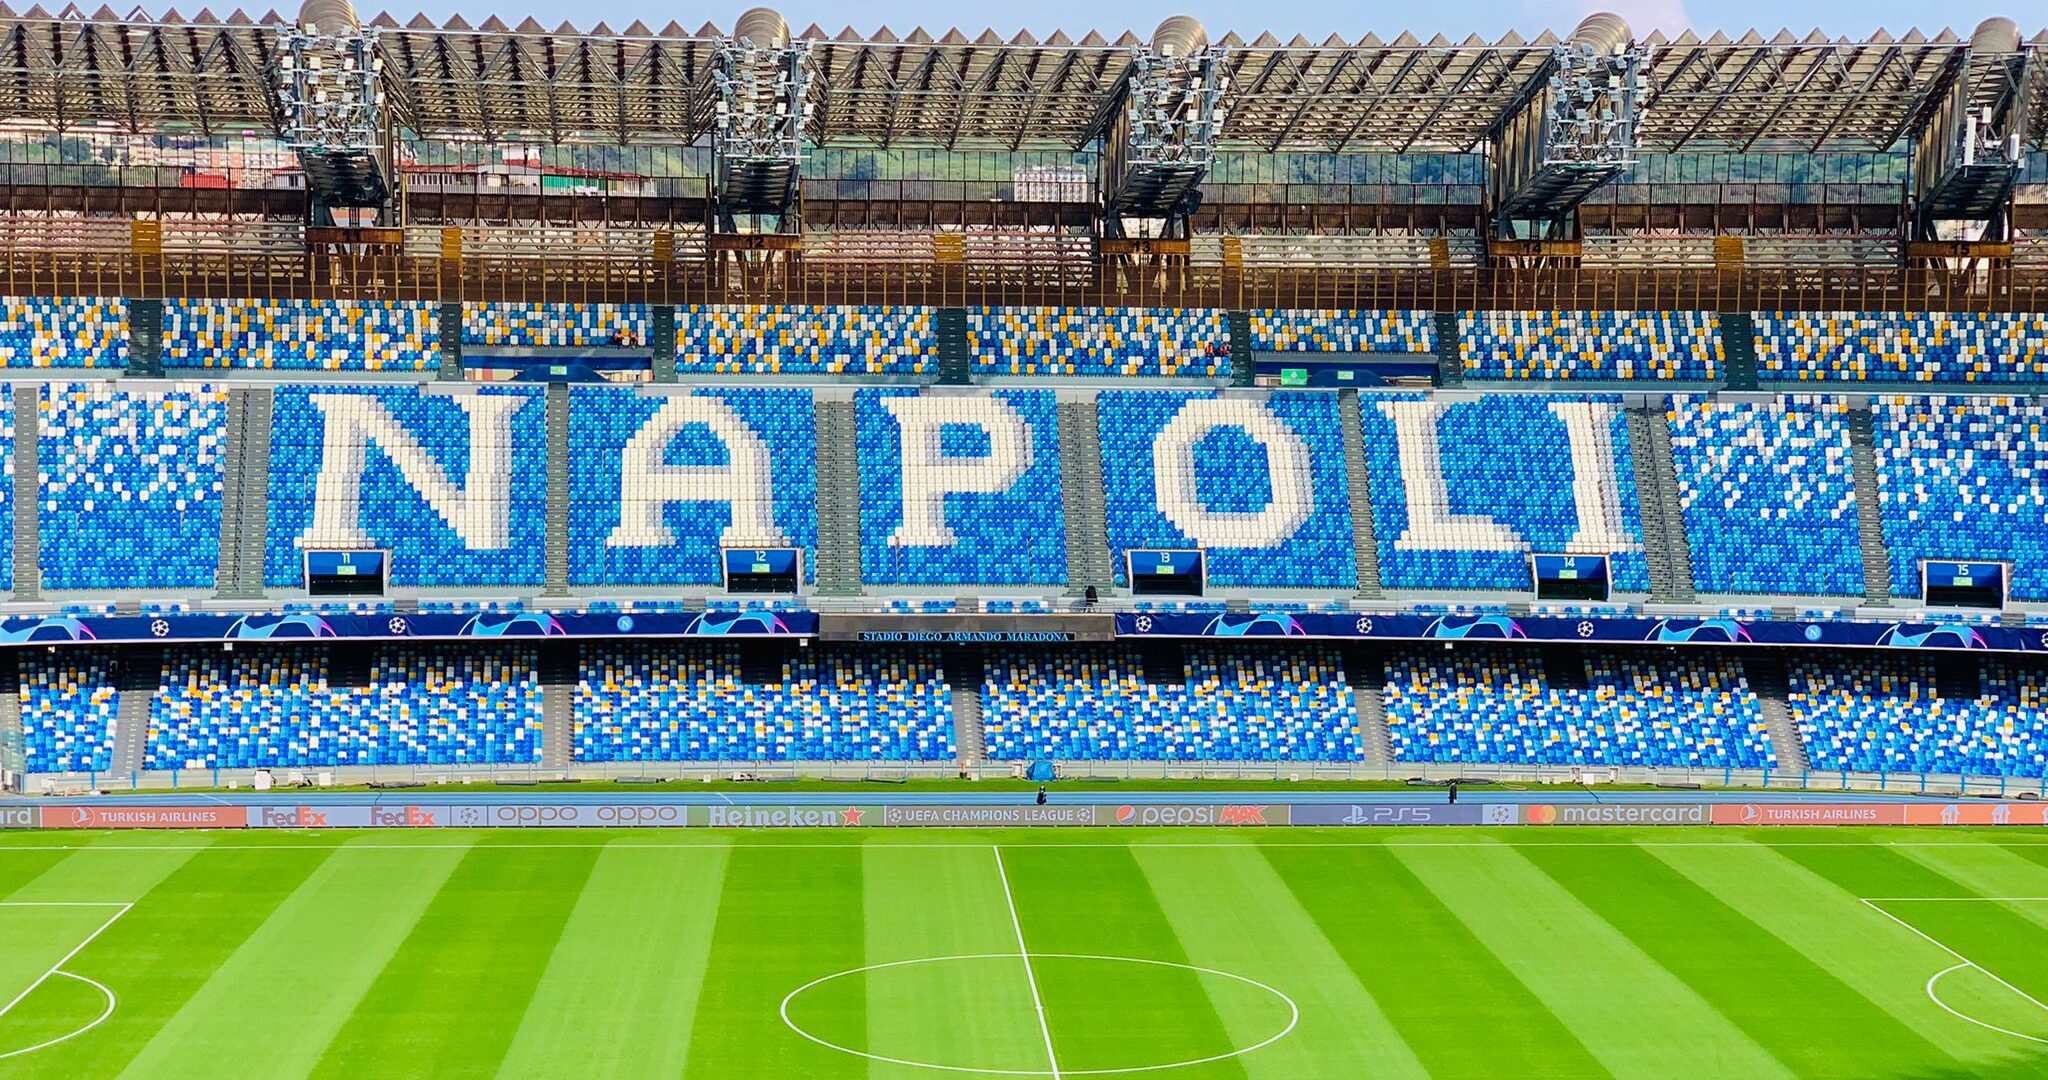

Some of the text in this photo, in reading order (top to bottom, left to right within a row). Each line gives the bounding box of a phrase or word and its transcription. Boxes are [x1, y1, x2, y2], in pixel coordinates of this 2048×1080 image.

[747, 236, 764, 248] 12
[1134, 240, 1151, 252] 13
[1523, 240, 1542, 254] 14
[294, 393, 1646, 554] NAPOLI
[341, 552, 351, 564] 11
[755, 550, 767, 562] 12
[1160, 552, 1171, 563] 13
[1564, 556, 1576, 567] 14
[1957, 564, 1970, 576] 15
[863, 632, 1069, 641] STADIO DIEGO ARMANDO MARADONA
[100, 812, 217, 822] TURKISH AIRLINES
[262, 806, 327, 826] FedEx
[371, 806, 436, 826] FedEx
[496, 806, 579, 825] oppo
[596, 806, 678, 825] oppo
[707, 805, 839, 826] Heineken
[905, 809, 1074, 822] UEFA CHAMPIONS LEAGUE
[1141, 804, 1268, 825] pepsi MAX
[1373, 807, 1431, 821] PS5
[1563, 805, 1703, 822] mastercard
[1767, 809, 1877, 820] TURKISH AIRLINES
